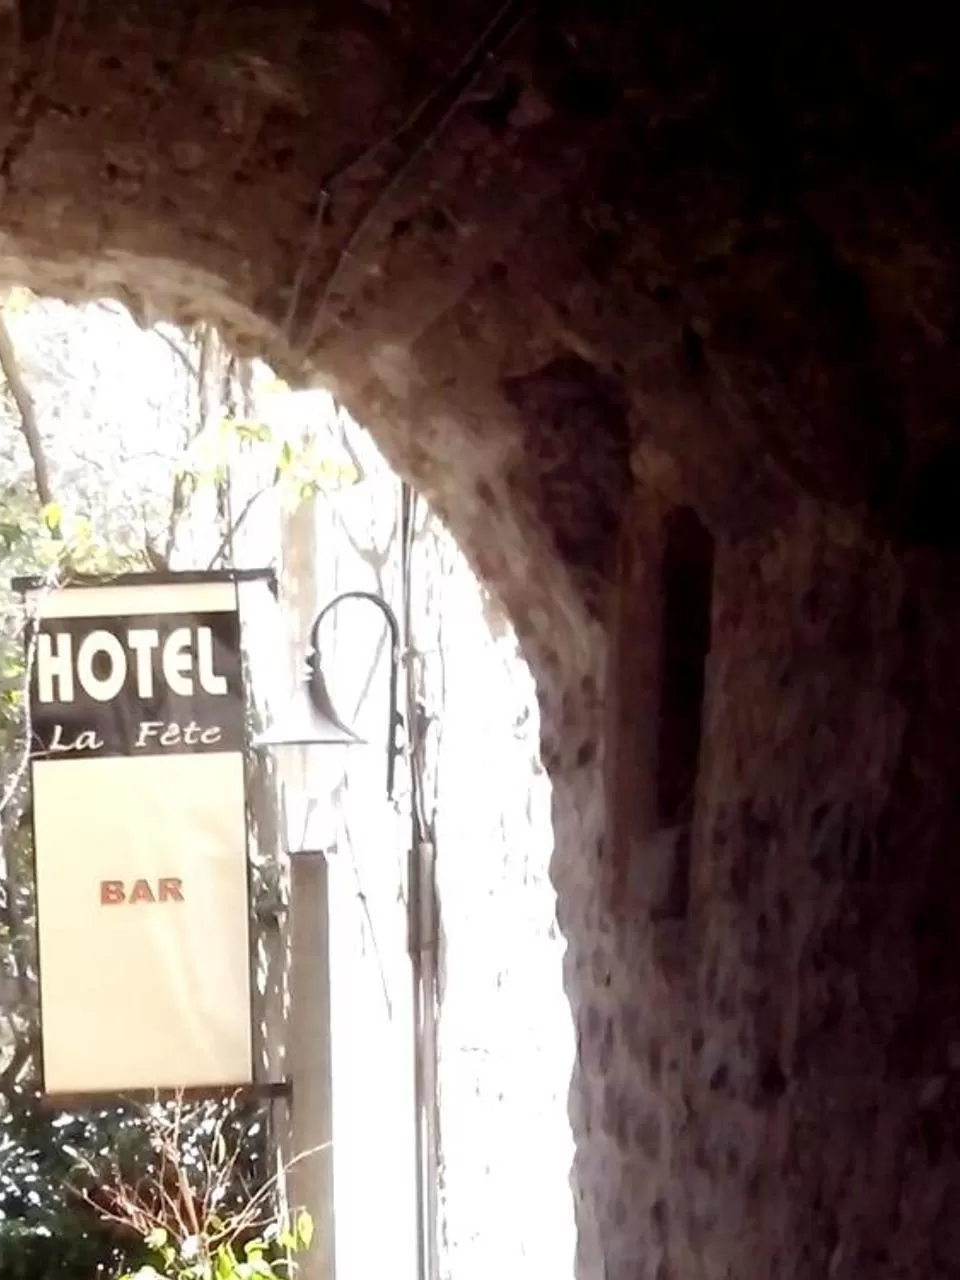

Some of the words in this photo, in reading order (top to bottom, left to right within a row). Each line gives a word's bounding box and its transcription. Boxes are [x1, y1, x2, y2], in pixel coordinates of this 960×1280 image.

[37, 626, 228, 703] HOTEL
[50, 725, 104, 751] La
[135, 721, 222, 747] Fête
[100, 877, 185, 905] BAR
